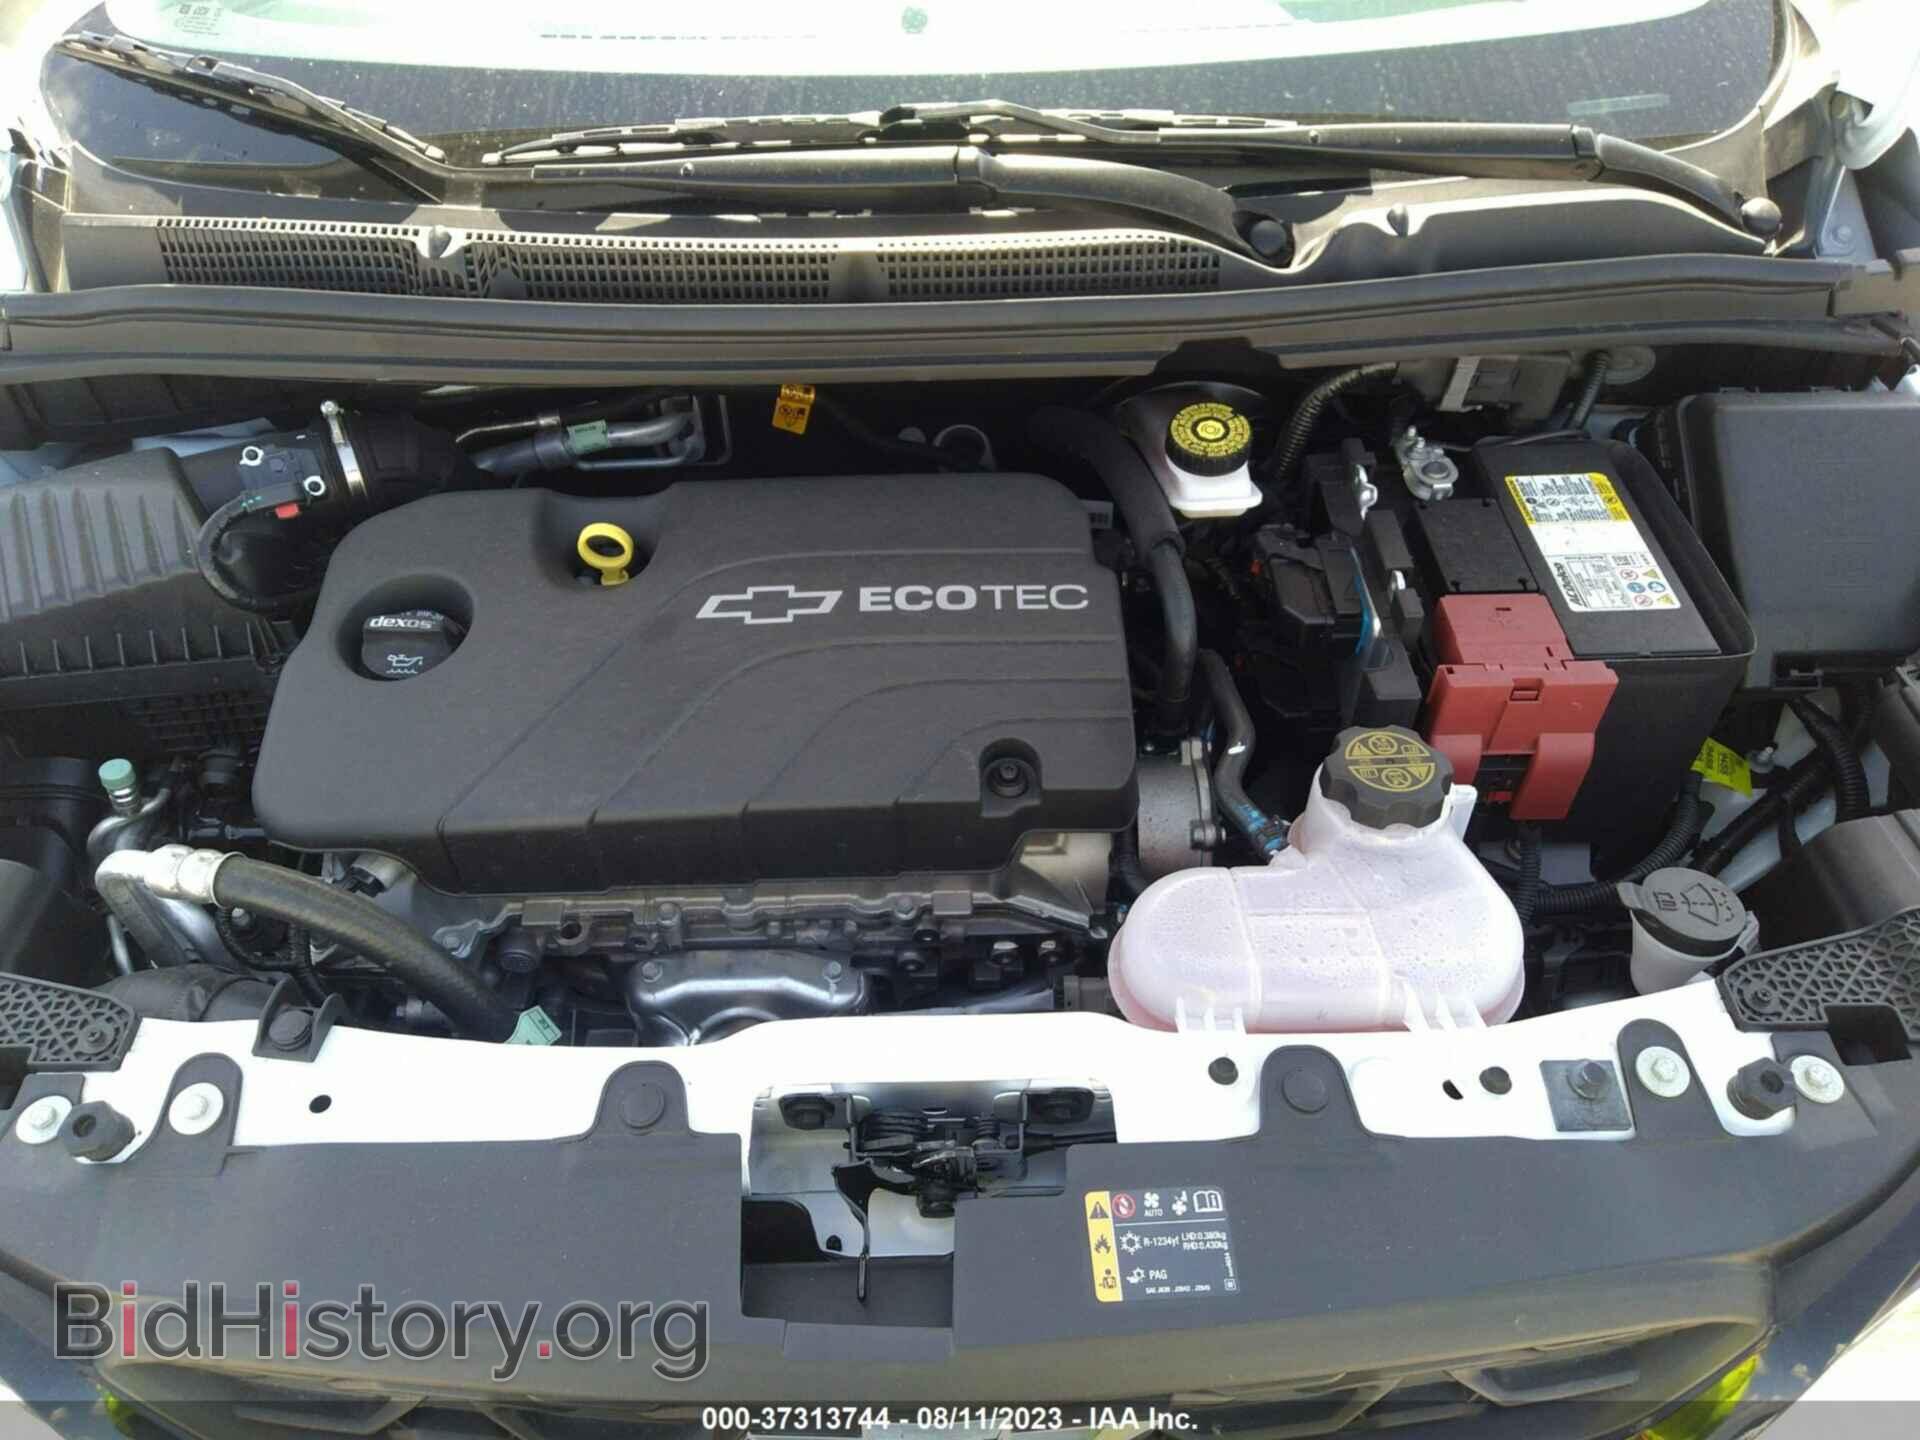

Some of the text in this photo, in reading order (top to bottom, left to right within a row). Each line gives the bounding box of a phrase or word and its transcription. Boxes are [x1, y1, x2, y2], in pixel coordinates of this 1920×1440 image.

[859, 584, 1089, 612] ECOTEC
[369, 616, 433, 629] dexos
[1144, 1208, 1163, 1217] AUTO
[1149, 1269, 1168, 1280] PAG
